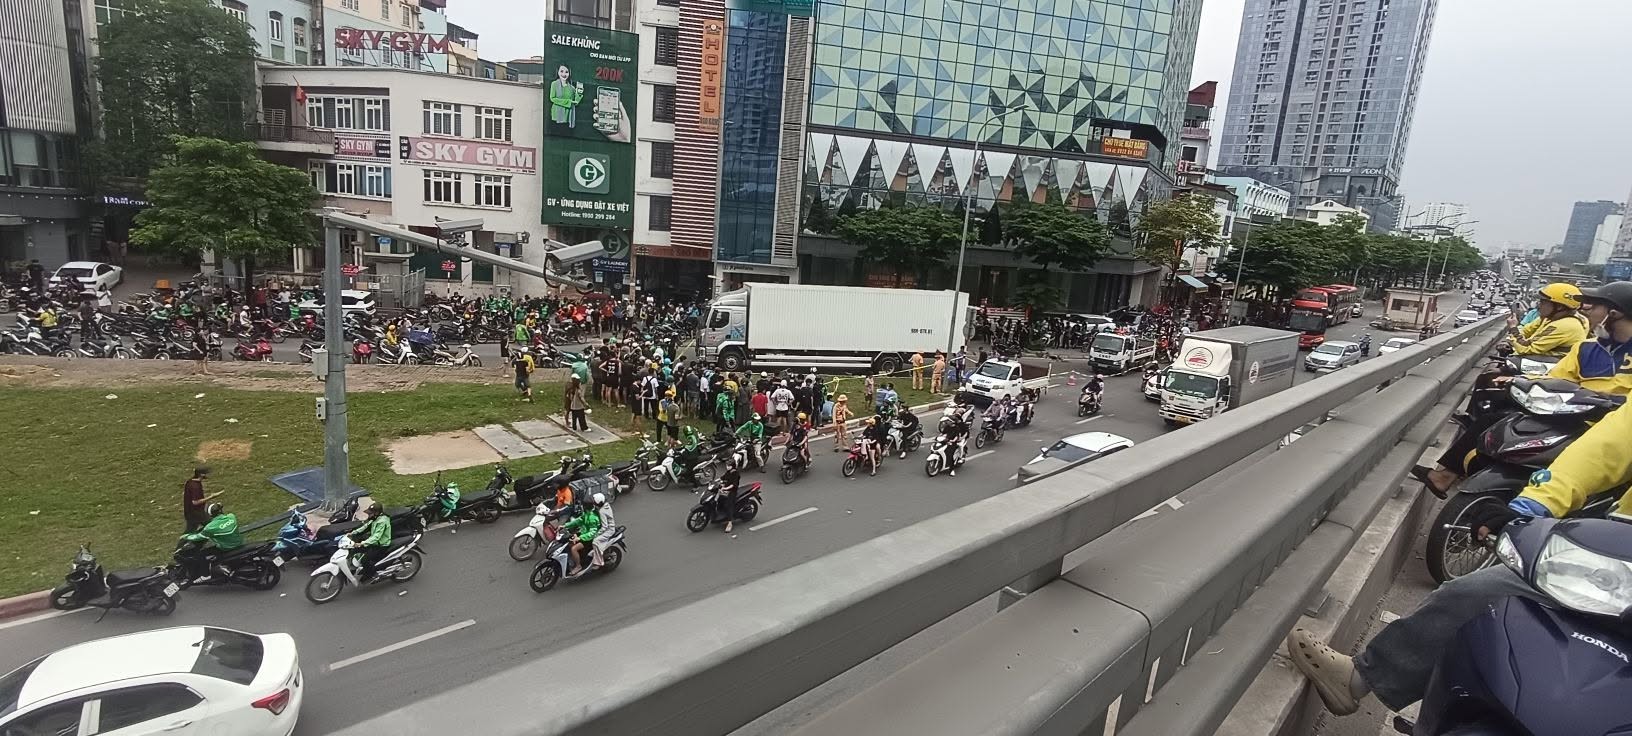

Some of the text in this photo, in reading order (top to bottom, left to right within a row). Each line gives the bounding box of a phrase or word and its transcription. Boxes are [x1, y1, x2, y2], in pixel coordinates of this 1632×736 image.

[335, 28, 449, 54] SKY GYM
[551, 34, 601, 50] SALE KHỦNG
[704, 37, 720, 113] HOTEL
[340, 139, 355, 150] SKY
[356, 141, 373, 152] GYM
[416, 141, 533, 169] SKY GYM
[547, 198, 556, 206] GV
[560, 197, 575, 208] ỨNG
[575, 200, 593, 210] DỤNG
[594, 201, 606, 212] ĐẶT
[607, 202, 616, 211] XE
[616, 202, 630, 214] VIỆT
[219, 519, 235, 530] Grab
[1570, 631, 1630, 663] HONDA
